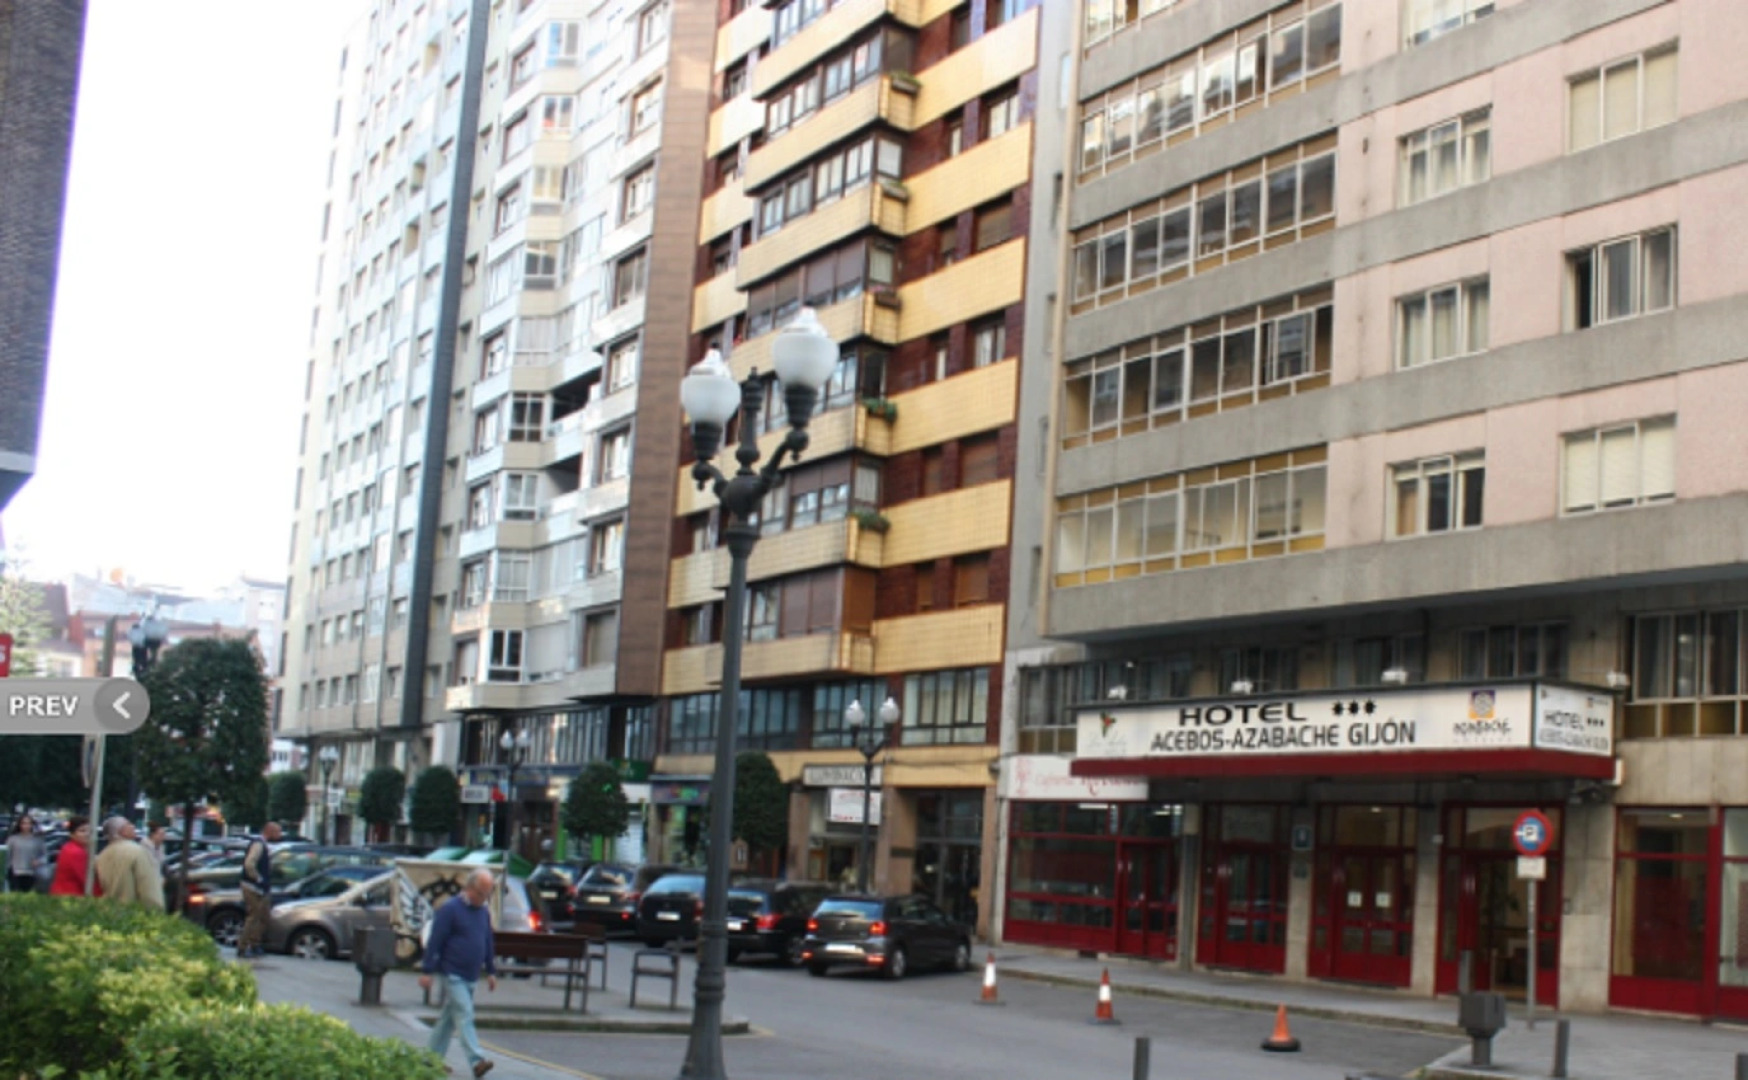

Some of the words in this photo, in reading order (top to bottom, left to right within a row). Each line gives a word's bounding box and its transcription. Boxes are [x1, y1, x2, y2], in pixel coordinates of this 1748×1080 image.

[1179, 702, 1307, 726] HOTEL
[1151, 724, 1340, 752] ACEBOS-AZABACHE
[1348, 717, 1416, 746] GIJÓN
